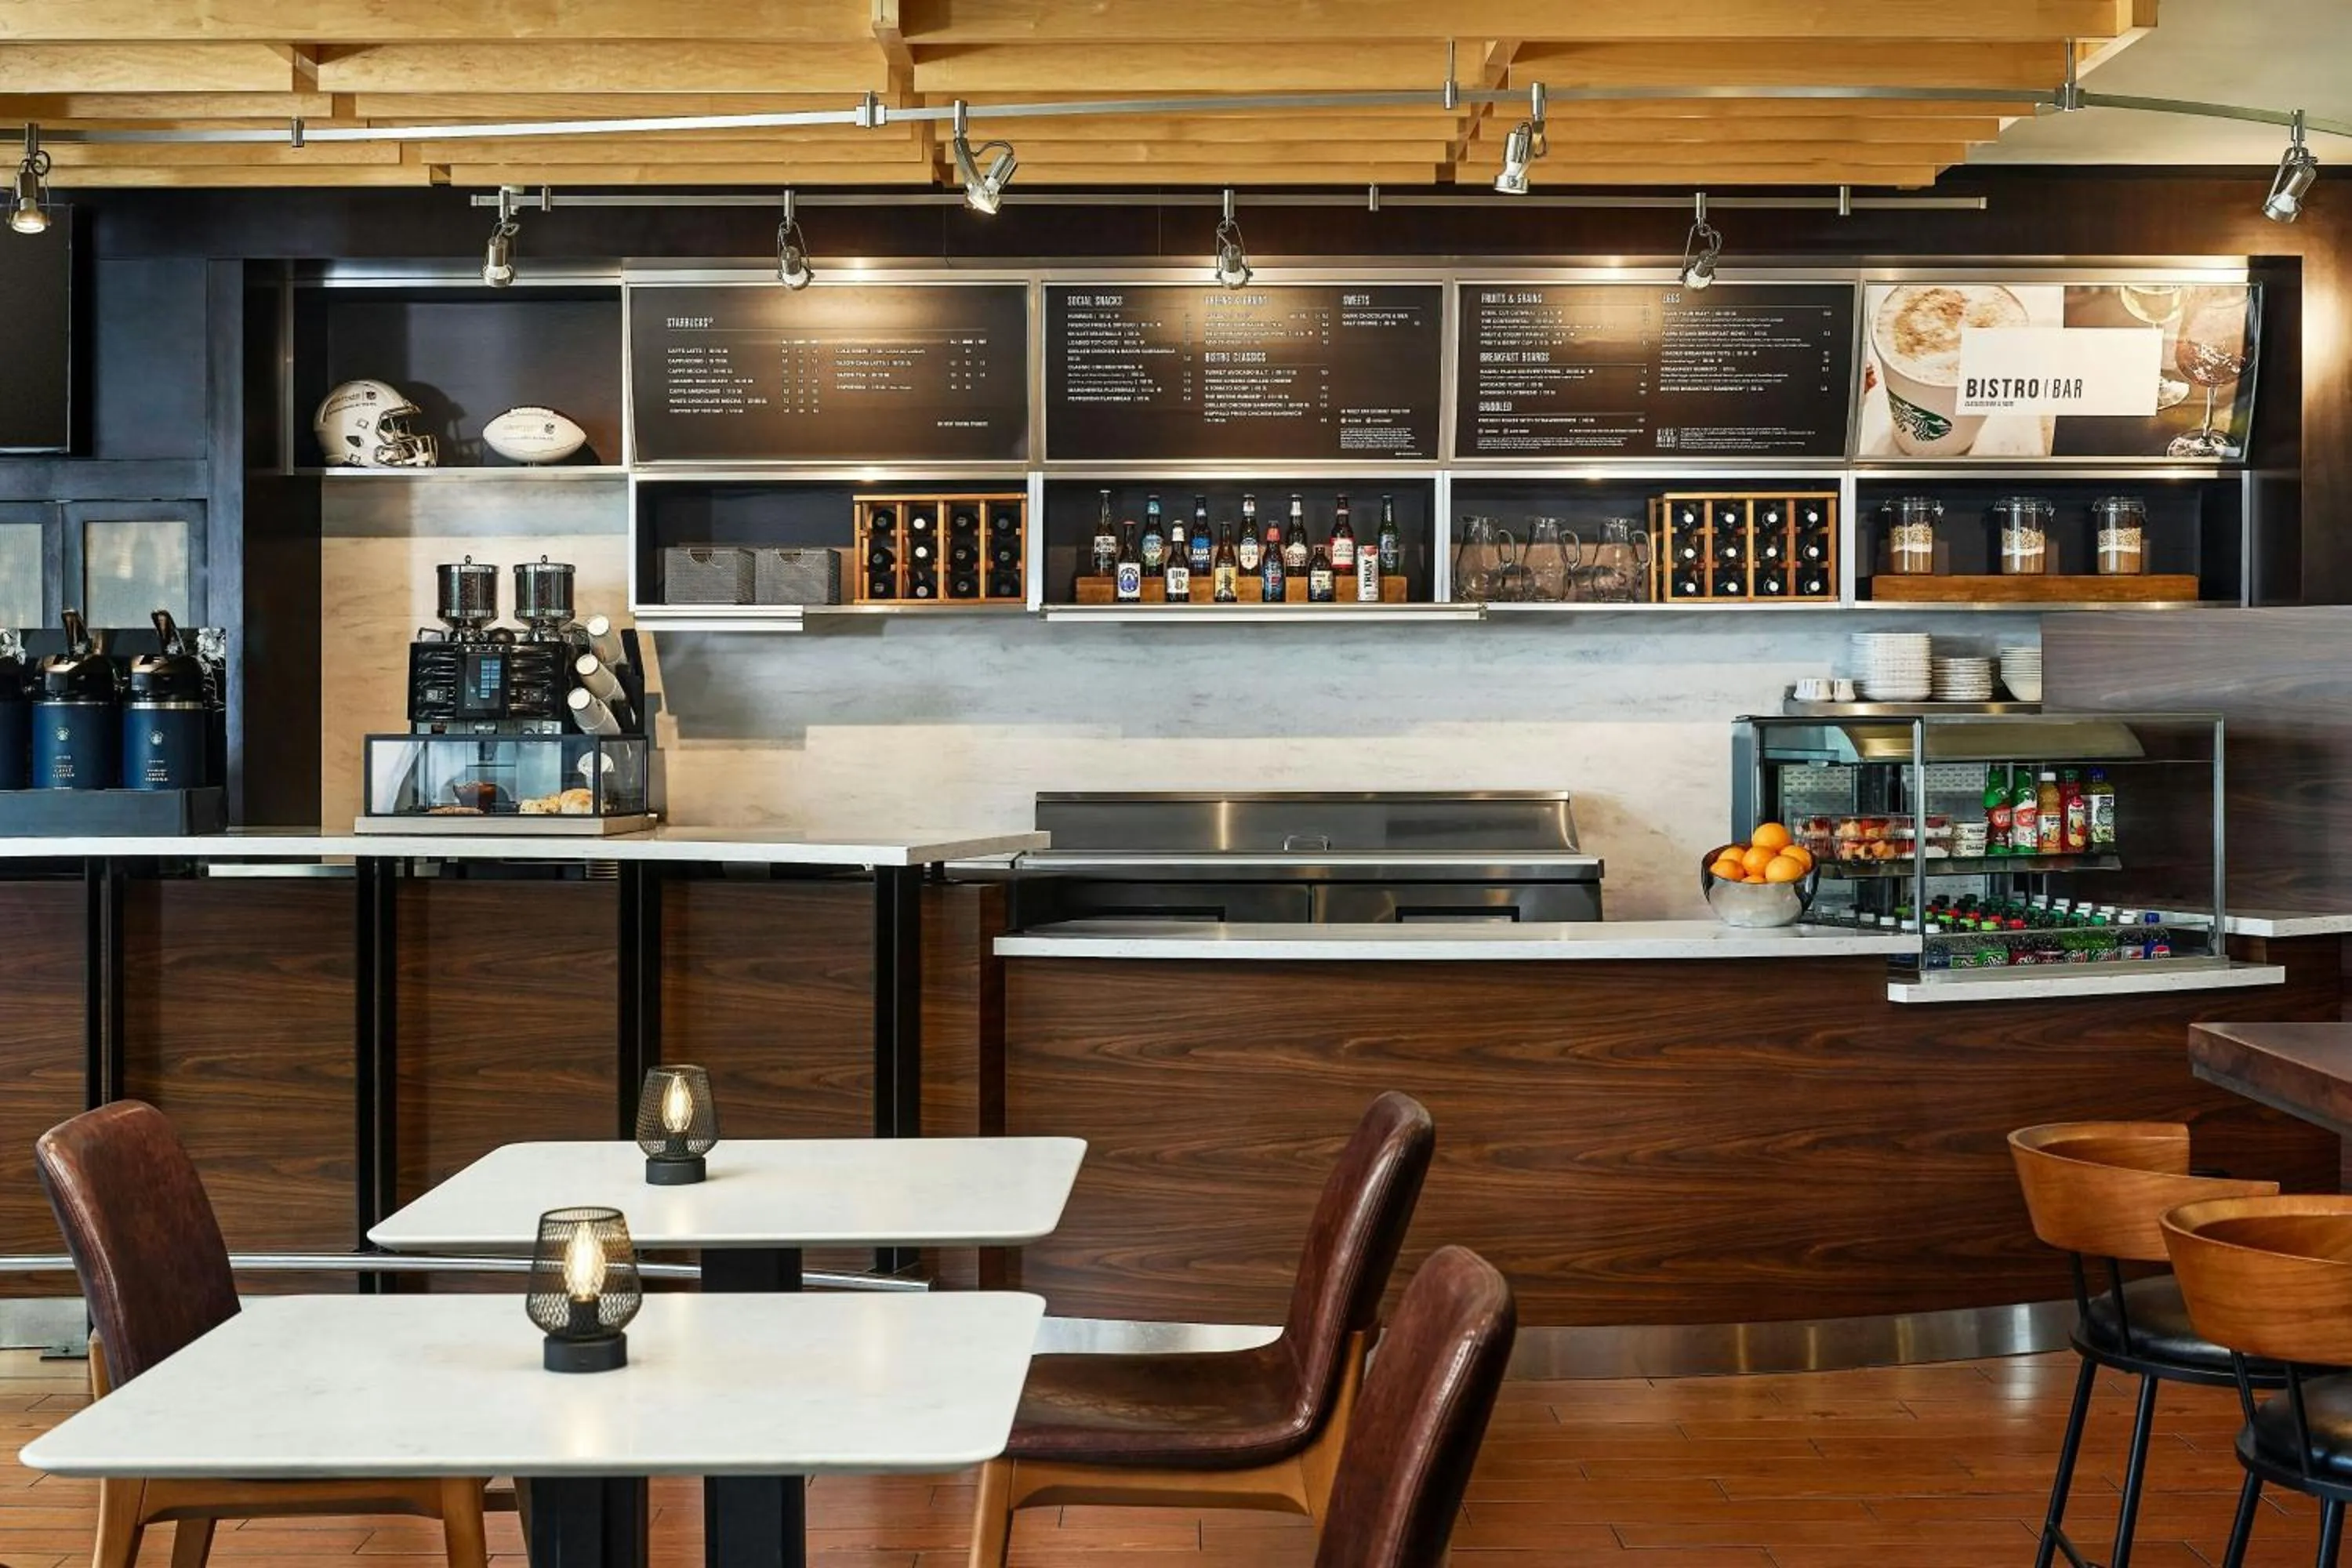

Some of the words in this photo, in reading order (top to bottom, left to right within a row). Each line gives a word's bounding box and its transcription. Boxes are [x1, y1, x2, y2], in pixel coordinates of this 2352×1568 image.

[1067, 296, 1091, 306] SOCIAL
[1095, 296, 1123, 306] SNACKS
[1343, 295, 1370, 306] SWEETS
[1481, 293, 1506, 303] FRUITS
[1508, 293, 1514, 303] &
[1205, 353, 1230, 362] BISTRO
[1233, 353, 1266, 362] CLASSICS
[1479, 352, 1519, 363] BREAKFAST
[1965, 378, 2039, 399] BISTRO
[2052, 378, 2083, 399] BAR
[1364, 559, 1373, 589] TRULY
